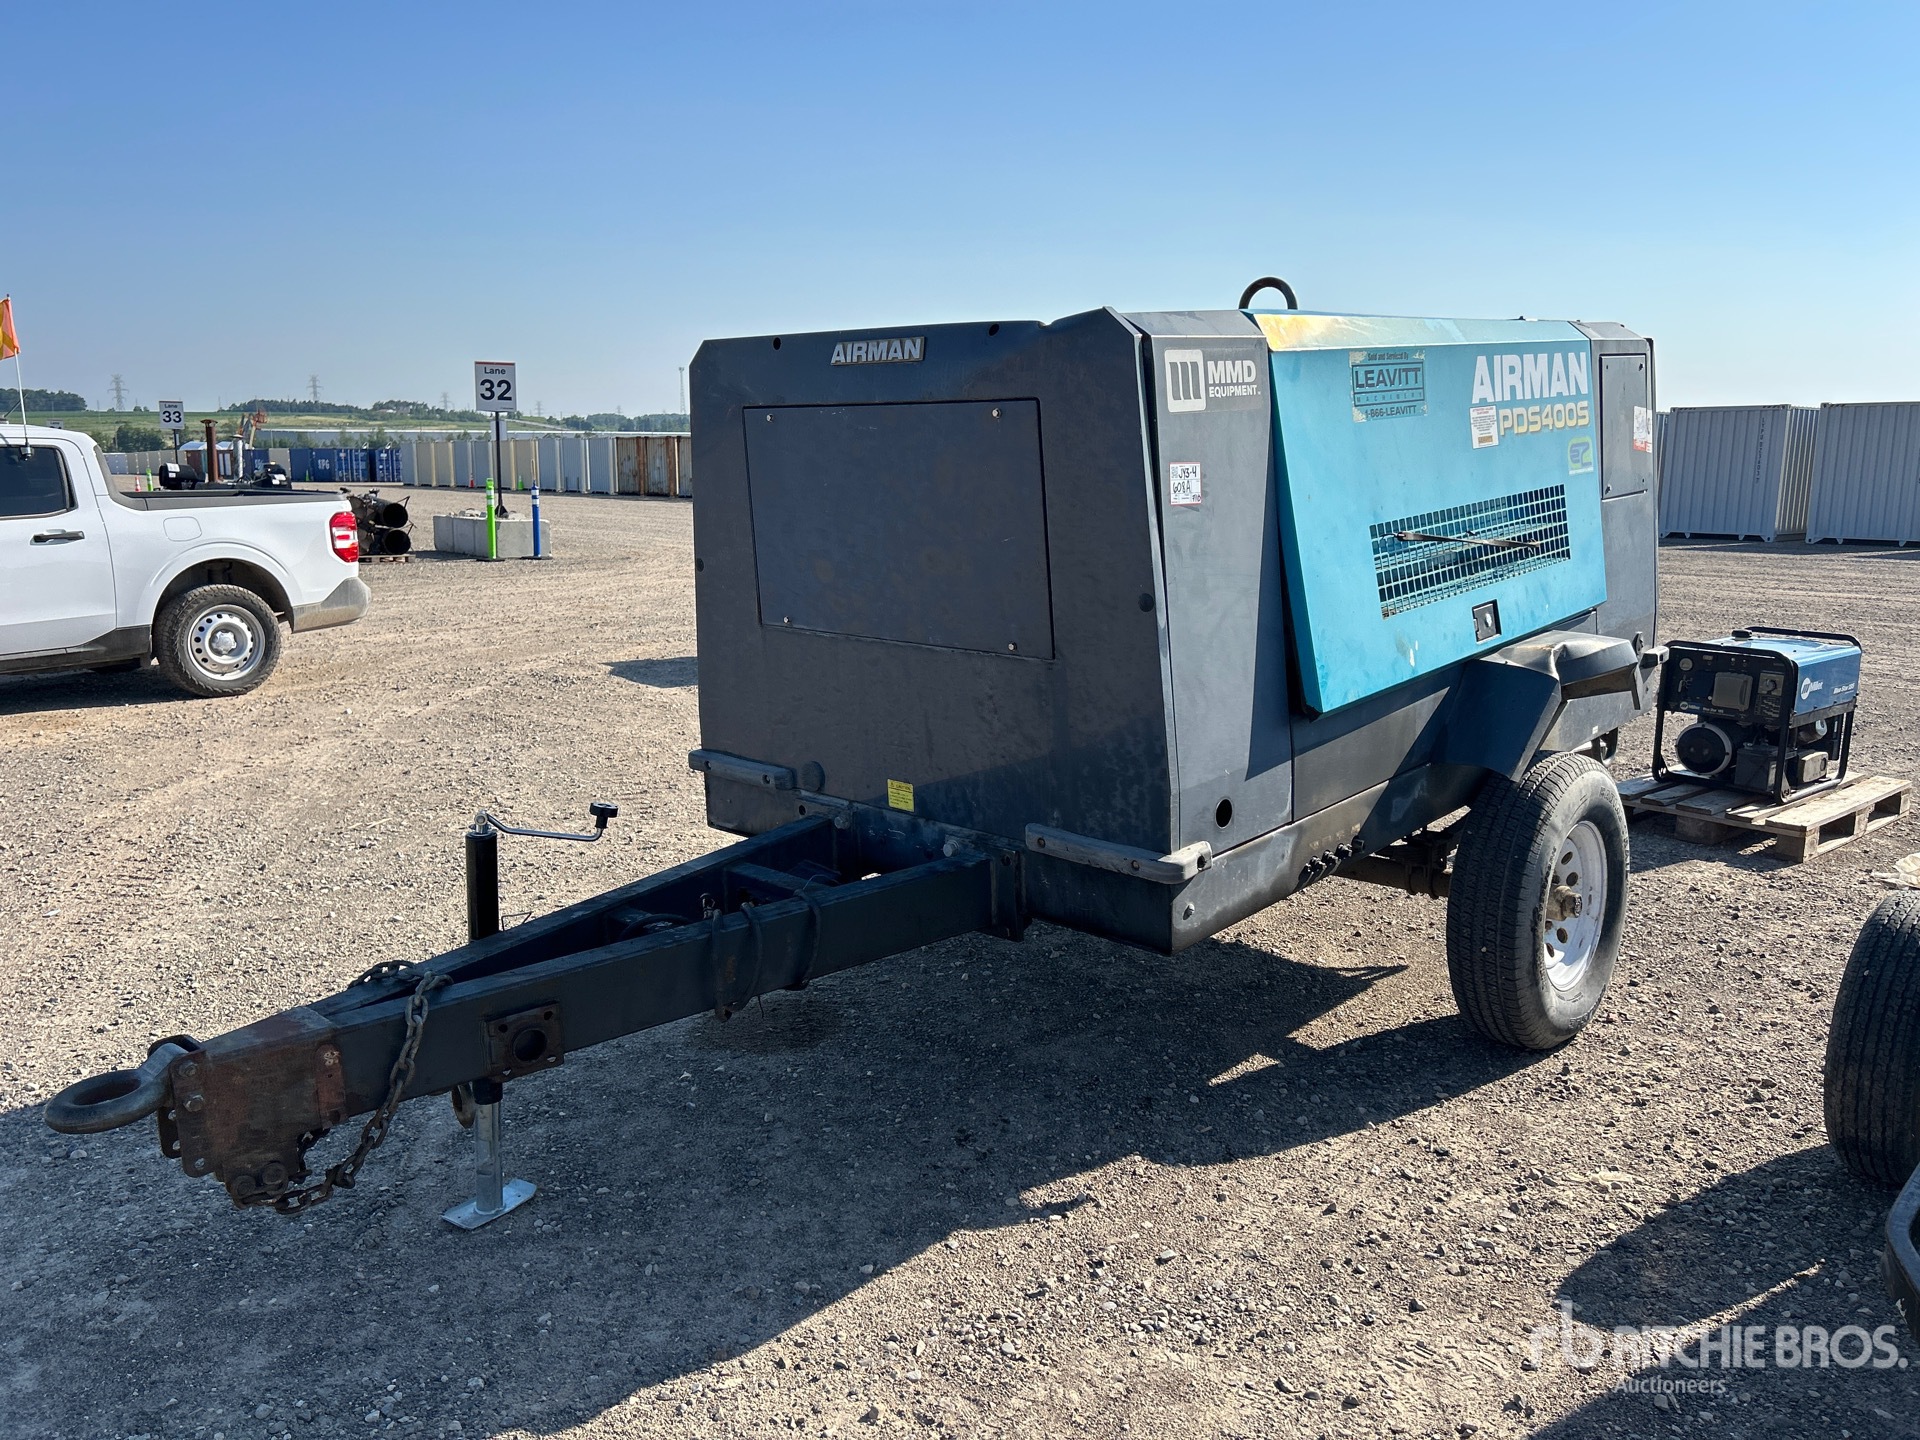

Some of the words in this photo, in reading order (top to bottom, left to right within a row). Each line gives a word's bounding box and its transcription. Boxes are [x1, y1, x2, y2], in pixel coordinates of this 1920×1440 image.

[831, 339, 922, 364] AIRMAN
[484, 366, 506, 375] Lane
[1207, 360, 1257, 384] MMD
[1355, 367, 1421, 388] LEAVITT
[1472, 352, 1588, 404] AIRMAN
[480, 379, 512, 401] 32
[162, 410, 182, 423] 33
[1365, 404, 1417, 418] 1-866-LEAVITT
[1499, 400, 1590, 436] PDS400S
